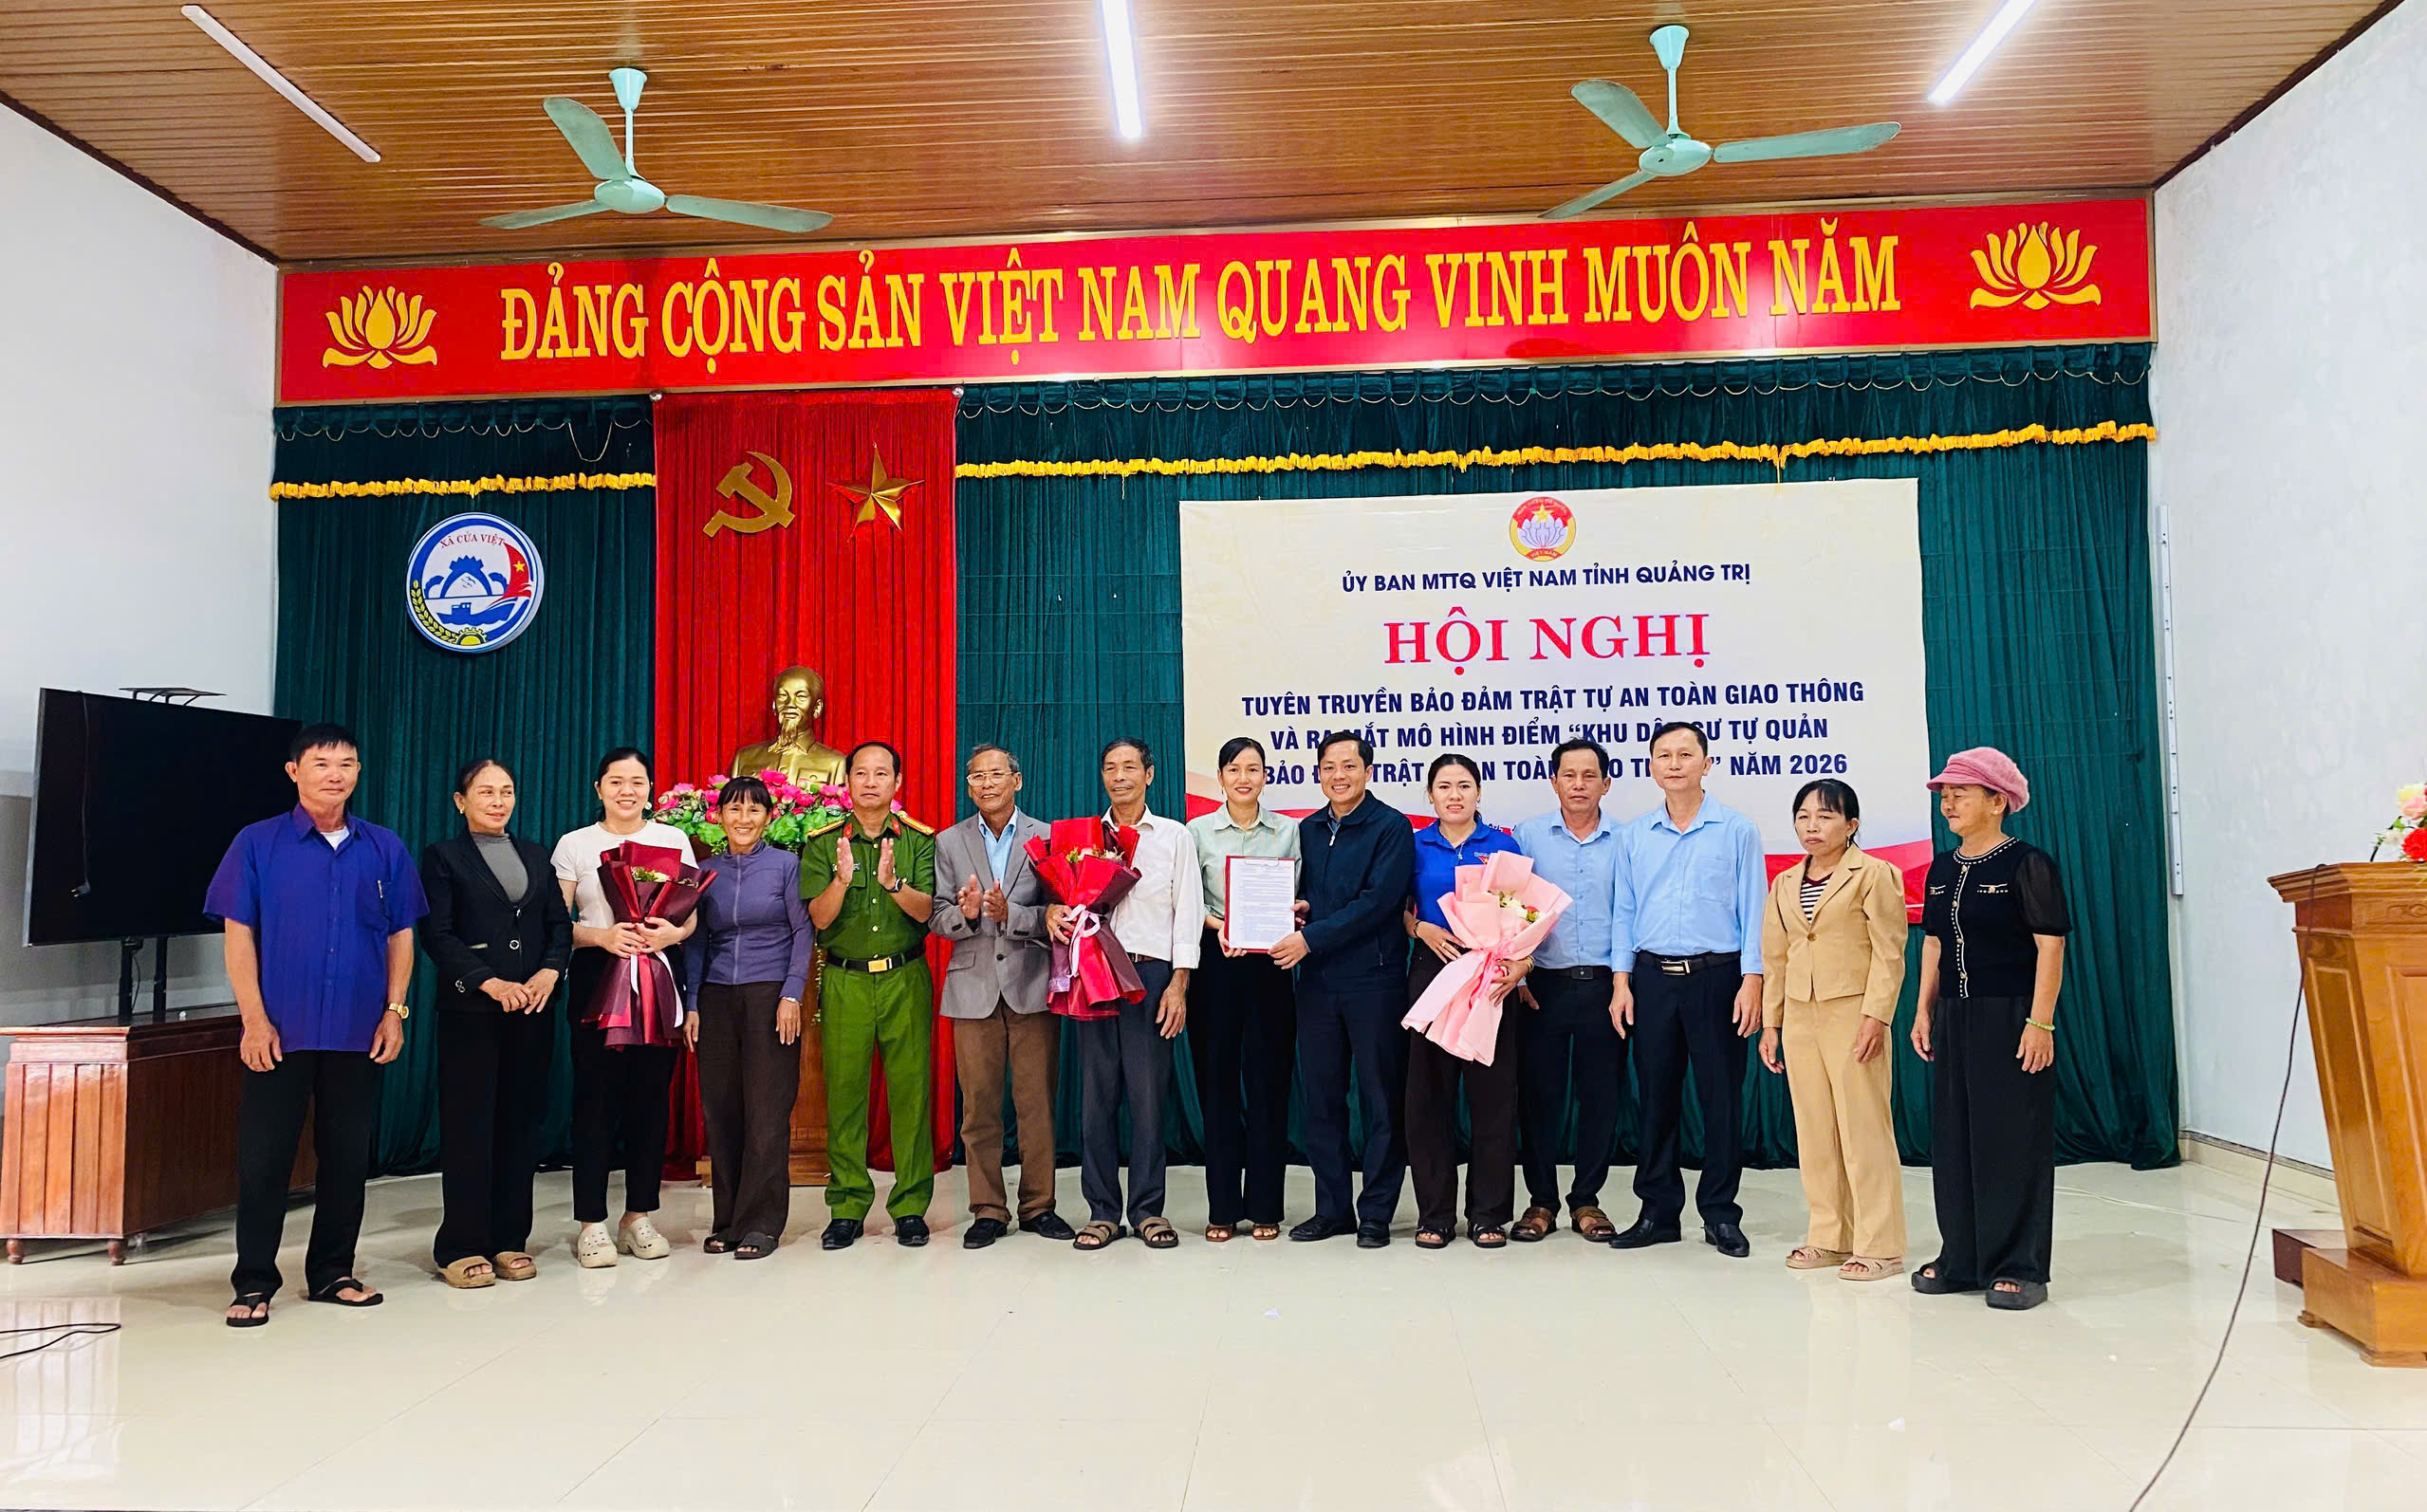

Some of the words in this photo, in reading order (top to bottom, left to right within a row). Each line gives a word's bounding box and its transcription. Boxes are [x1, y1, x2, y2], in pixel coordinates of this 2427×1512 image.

[500, 262, 649, 360] ĐẢNG
[661, 257, 806, 374] CỘNG
[817, 249, 925, 353] SẢN
[938, 248, 1064, 365] VIỆT
[1078, 265, 1200, 341] NAM
[1216, 256, 1412, 344] QUANG
[1425, 249, 1569, 328] VINH
[1583, 221, 1751, 323] MUÔN
[1769, 217, 1901, 317] NĂM
[440, 536, 454, 549] XÃ
[481, 533, 506, 546] VIỆT
[1343, 569, 1368, 593] ỦY
[1374, 575, 1416, 591] BAN
[1423, 572, 1476, 589] MTTQ
[1482, 566, 1524, 592] VIỆT
[1528, 569, 1577, 587] NAM
[1582, 562, 1629, 585] TỈNH
[1637, 561, 1715, 584] QUẢNG
[1721, 563, 1751, 585] TRỊ
[1384, 606, 1509, 676] HỘI
[1528, 613, 1711, 669] NGHỊ
[1241, 691, 1310, 716] TUYÊN
[1318, 687, 1402, 714] TRUYỀN
[1411, 687, 1454, 712] BẢO
[1461, 685, 1512, 711] ĐẢM
[1520, 685, 1577, 713] TRẬT
[1584, 685, 1613, 712] TỰ
[1620, 688, 1649, 708] AN
[1658, 681, 1716, 707] TOÀN
[1725, 684, 1779, 705] GIAO
[1786, 677, 1863, 704] THÔNG
[1270, 727, 1299, 750] VÀ
[1398, 723, 1432, 747] MÔ
[1441, 723, 1494, 747] HÌNH
[1502, 717, 1560, 746] ĐIỂM
[1729, 716, 1759, 745] TỰ
[1766, 713, 1828, 742] QUẢN
[1372, 758, 1425, 786] TRẬT
[1731, 751, 1782, 776] NĂM
[1789, 754, 1847, 775] 2026
